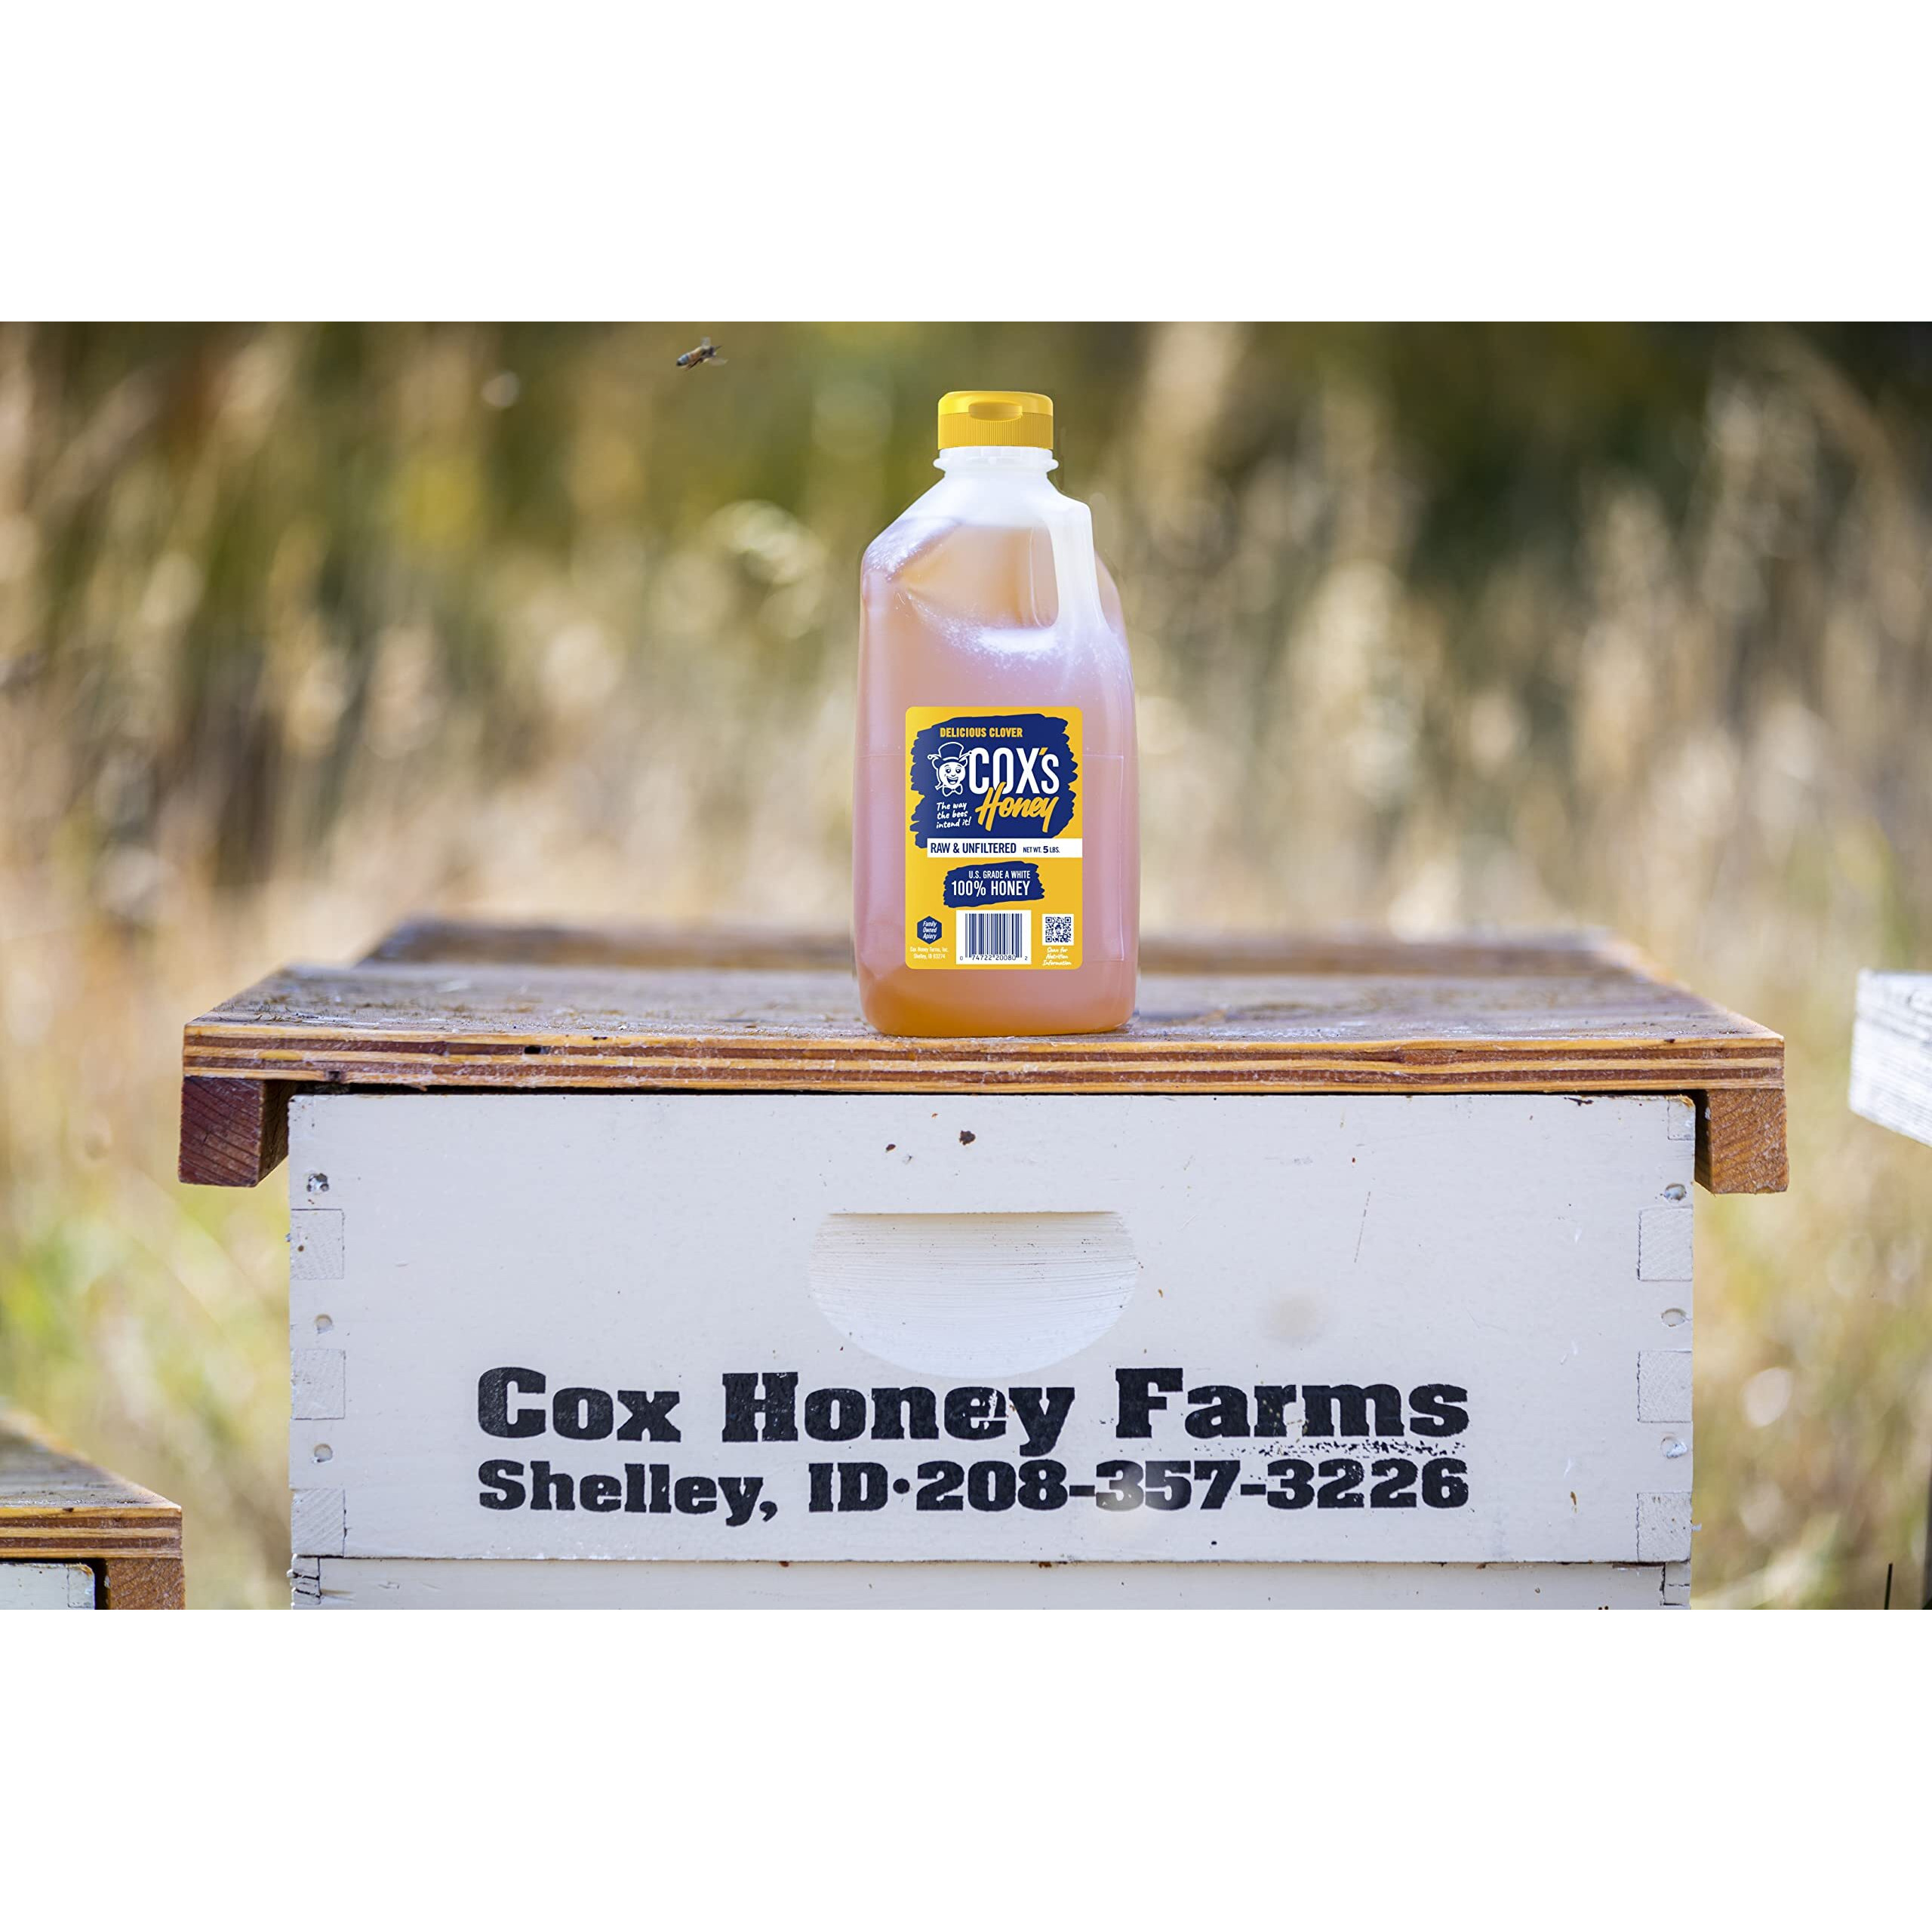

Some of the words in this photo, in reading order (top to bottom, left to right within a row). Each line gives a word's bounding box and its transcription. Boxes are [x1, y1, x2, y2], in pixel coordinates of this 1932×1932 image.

[940, 727, 986, 738] DELICIOUS
[989, 727, 1023, 738] CLOVER
[936, 801, 951, 811] The
[952, 802, 968, 811] way
[974, 781, 1060, 833] Honey
[937, 811, 950, 820] the
[952, 809, 968, 818] bees
[936, 818, 961, 829] intend
[961, 816, 972, 826] it!
[930, 842, 950, 854] RAW
[952, 843, 960, 854] &
[962, 842, 1017, 854] UNFILTERED
[1043, 845, 1049, 854] 5
[968, 870, 981, 879] U.S.
[983, 870, 1004, 879] GRADE
[1004, 870, 1010, 879] A
[1011, 870, 1031, 879] WHITE
[951, 880, 986, 897] 100%
[990, 880, 1031, 896] HONEY
[478, 1367, 681, 1442] Cox
[721, 1371, 1075, 1457] Honey
[1115, 1367, 1470, 1438] Farms
[478, 1459, 778, 1527] Shelley,
